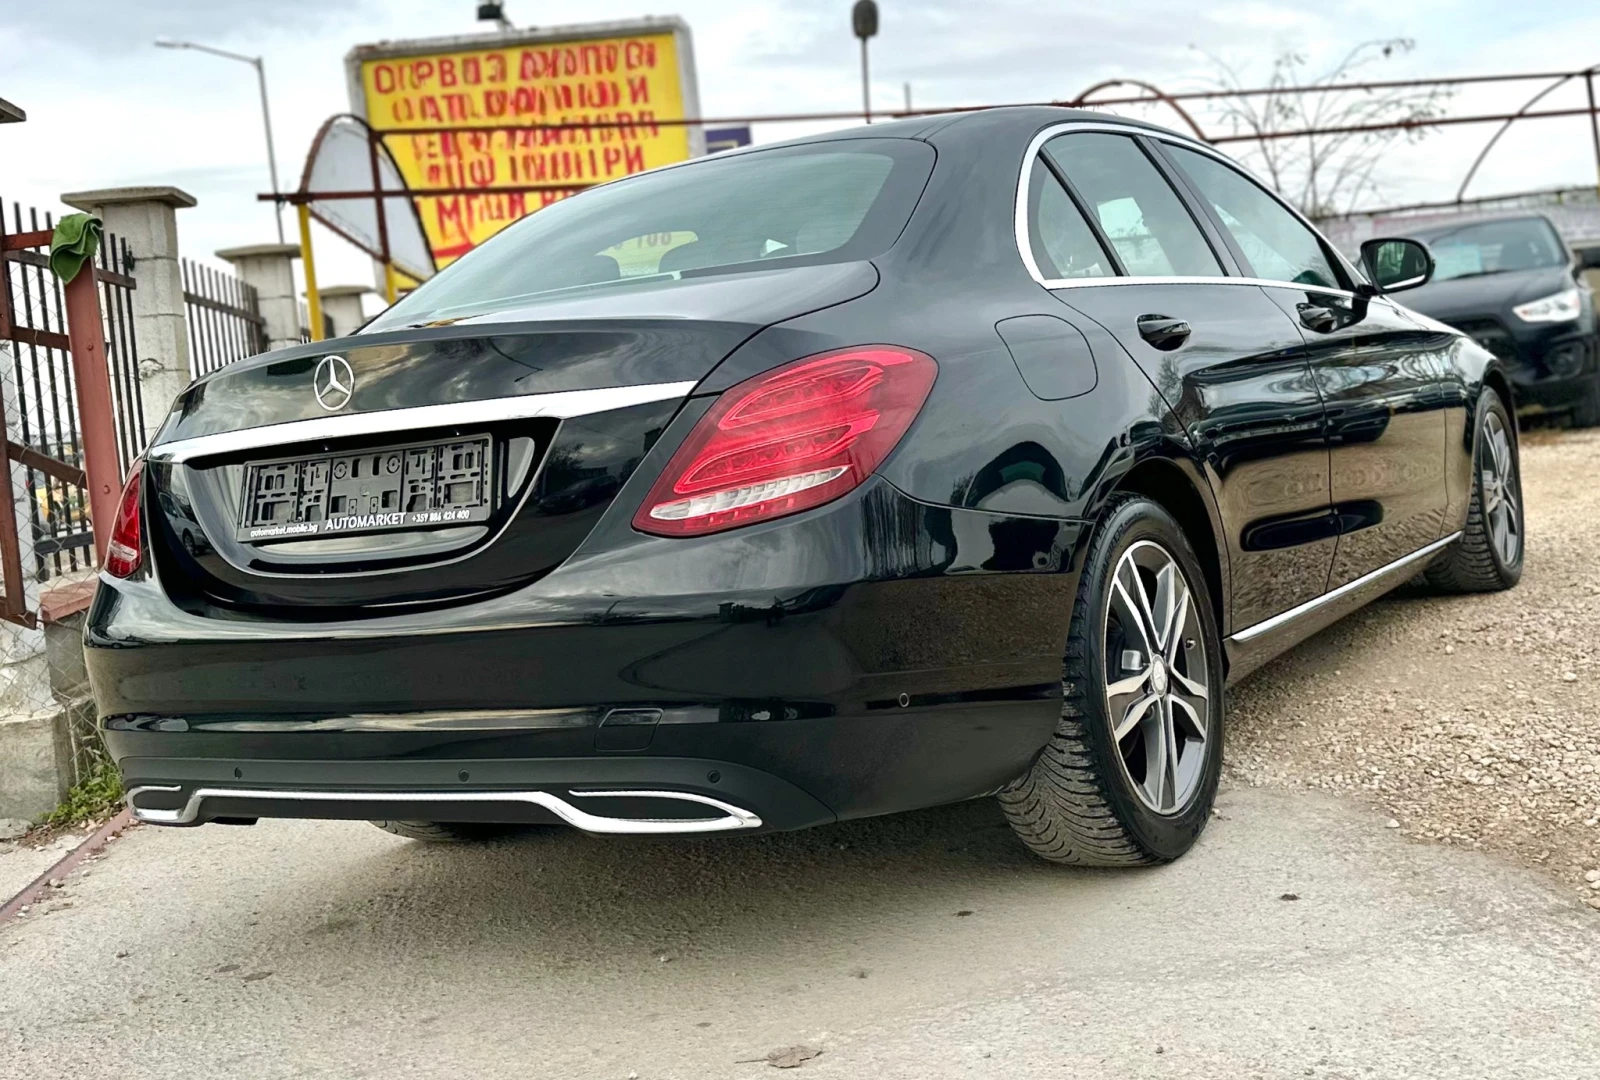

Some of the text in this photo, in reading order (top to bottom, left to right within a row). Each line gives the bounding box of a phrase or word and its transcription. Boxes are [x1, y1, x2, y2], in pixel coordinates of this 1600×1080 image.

[325, 512, 406, 531] AUTOMARKET
[411, 512, 428, 523] +359
[456, 509, 470, 520] 400
